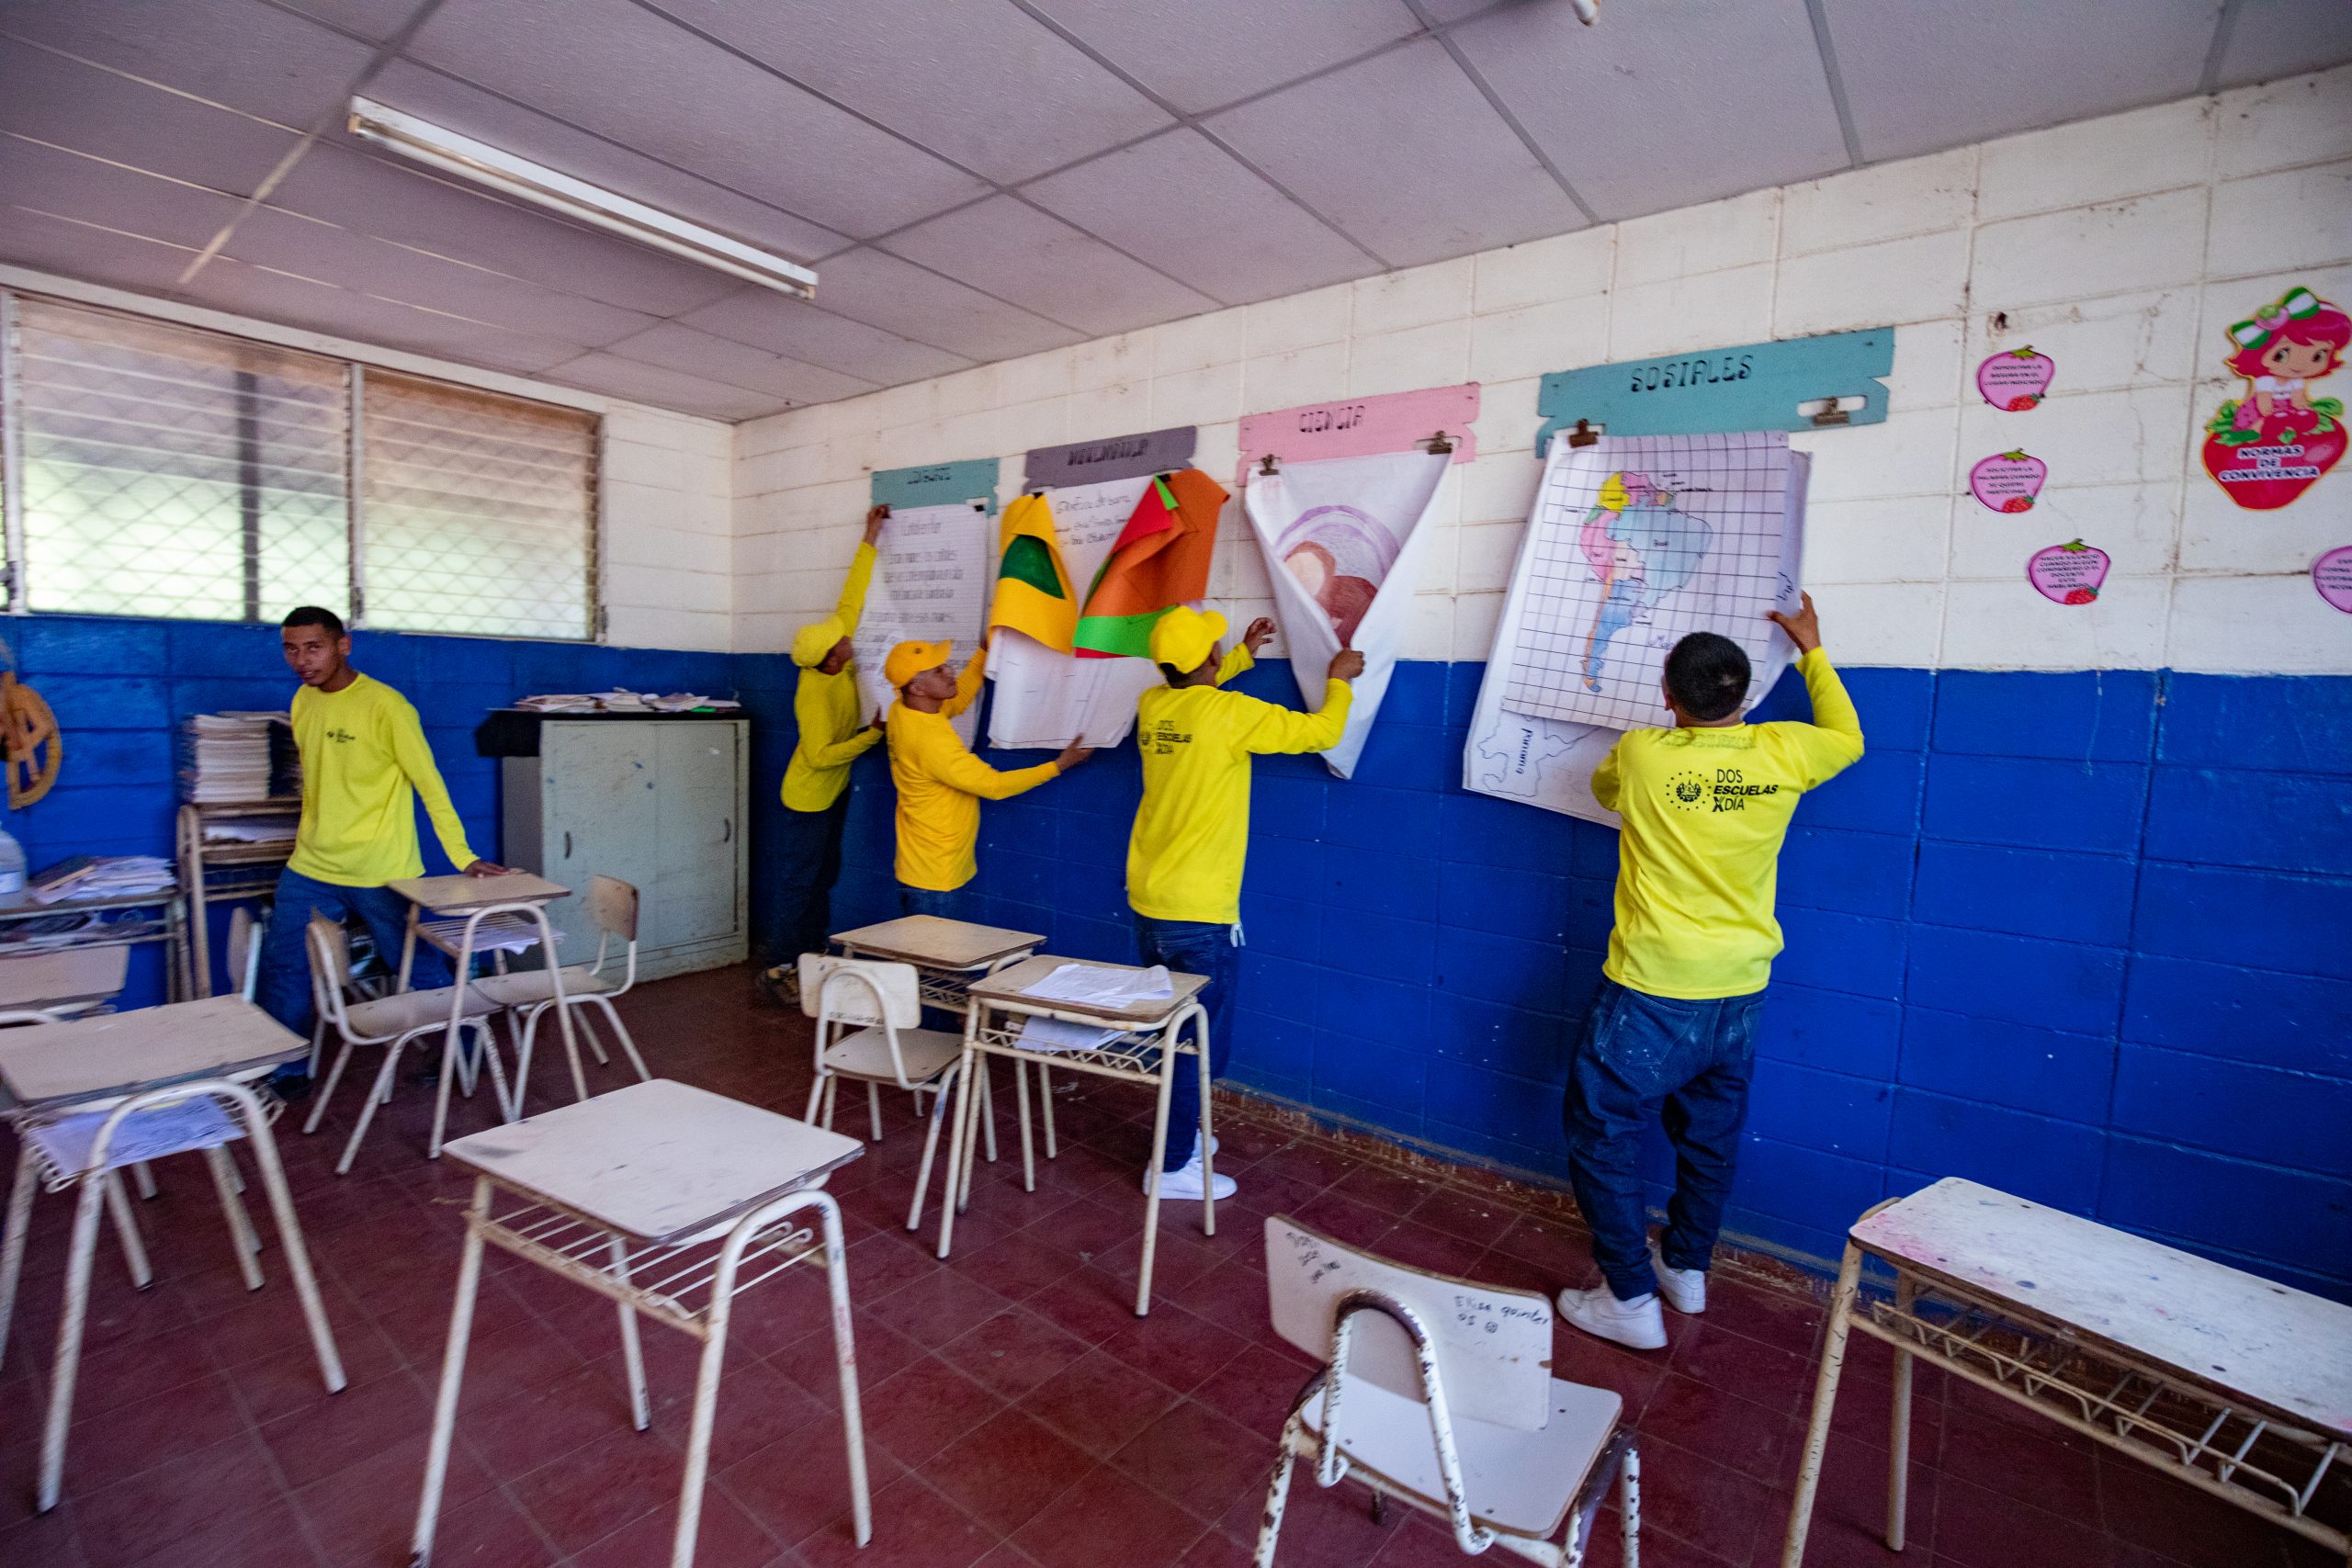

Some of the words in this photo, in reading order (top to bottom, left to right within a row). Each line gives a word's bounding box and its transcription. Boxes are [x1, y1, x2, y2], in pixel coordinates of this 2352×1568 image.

[1631, 355, 1754, 392] SOSIALES
[2238, 446, 2304, 459] NORMAS
[2258, 458, 2280, 468] DE
[2219, 467, 2321, 481] CONVIVENCIA
[1716, 769, 1743, 784] DOS
[1713, 784, 1779, 795] ESCUELAS
